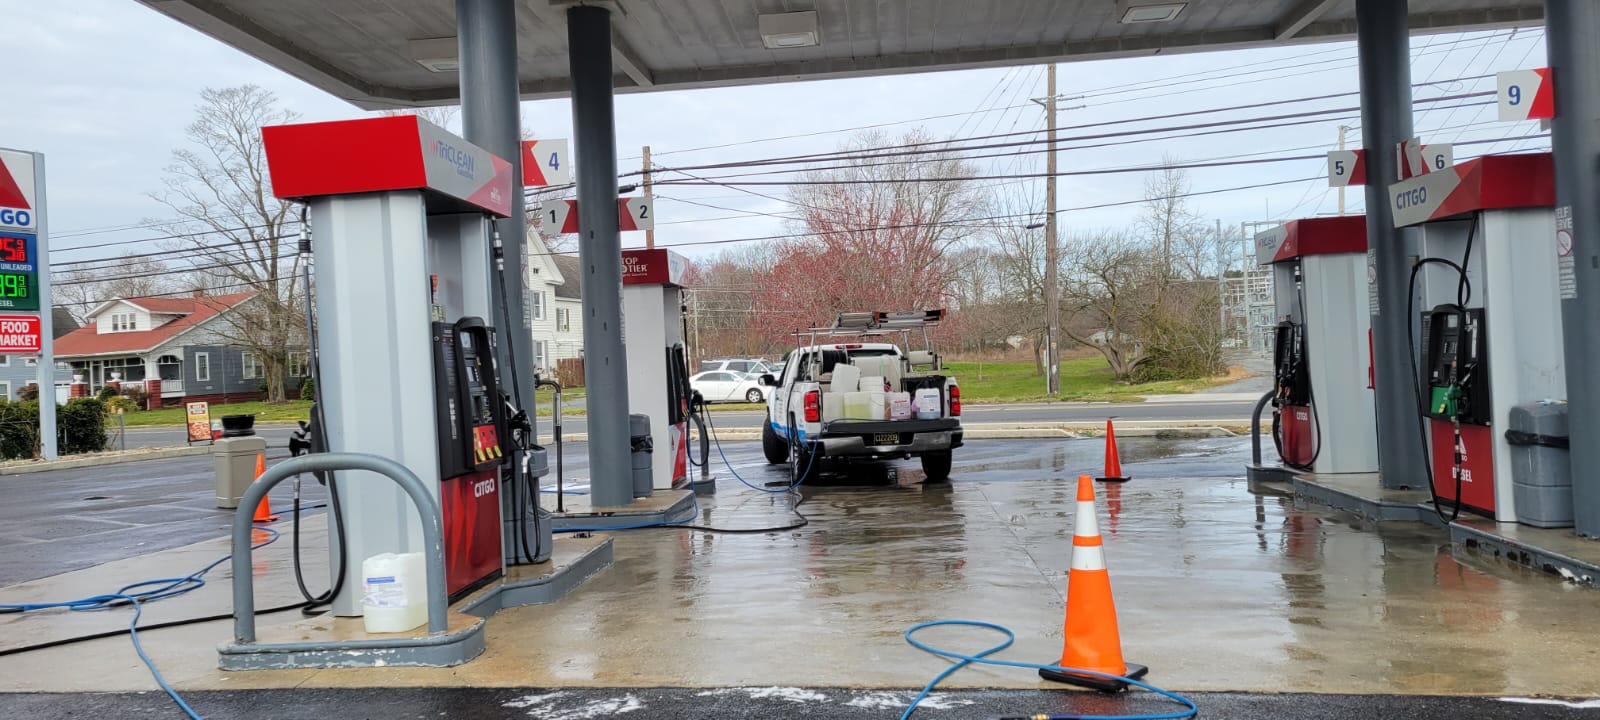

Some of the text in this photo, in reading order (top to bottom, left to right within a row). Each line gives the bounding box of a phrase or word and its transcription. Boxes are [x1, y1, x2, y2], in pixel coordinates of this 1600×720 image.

[1508, 85, 1521, 106] 9
[548, 151, 560, 171] 4
[1335, 160, 1345, 176] 5
[1435, 154, 1445, 169] 6
[1396, 186, 1427, 210] CITGO
[549, 209, 556, 224] 1
[639, 204, 649, 219] 2
[0, 263, 32, 271] UNLEADED
[628, 264, 648, 273] TIER
[1, 321, 30, 333] FOOD
[474, 479, 495, 497] CITGO
